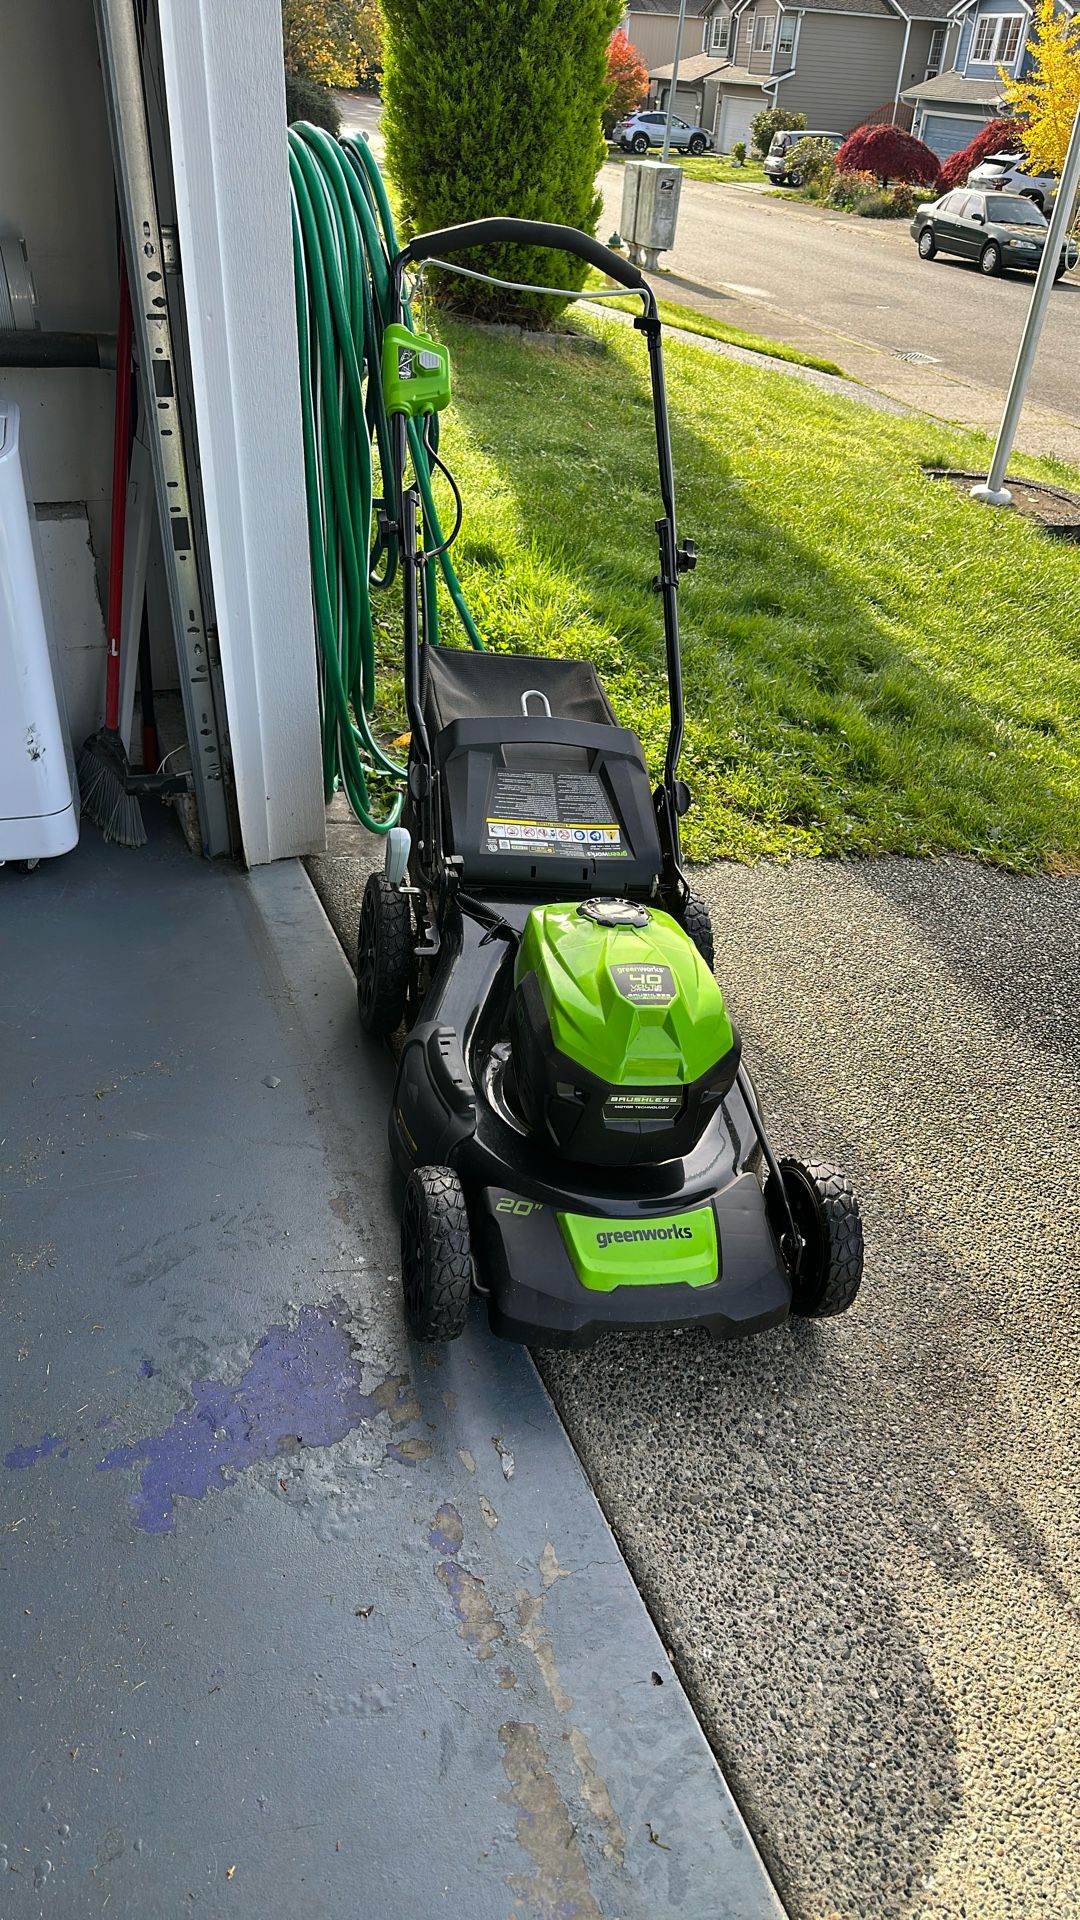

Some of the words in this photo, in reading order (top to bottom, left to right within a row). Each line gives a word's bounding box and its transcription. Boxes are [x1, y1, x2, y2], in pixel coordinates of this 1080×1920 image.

[617, 965, 663, 973] greenworks
[629, 974, 661, 984] 40
[596, 1224, 693, 1248] greenworks
